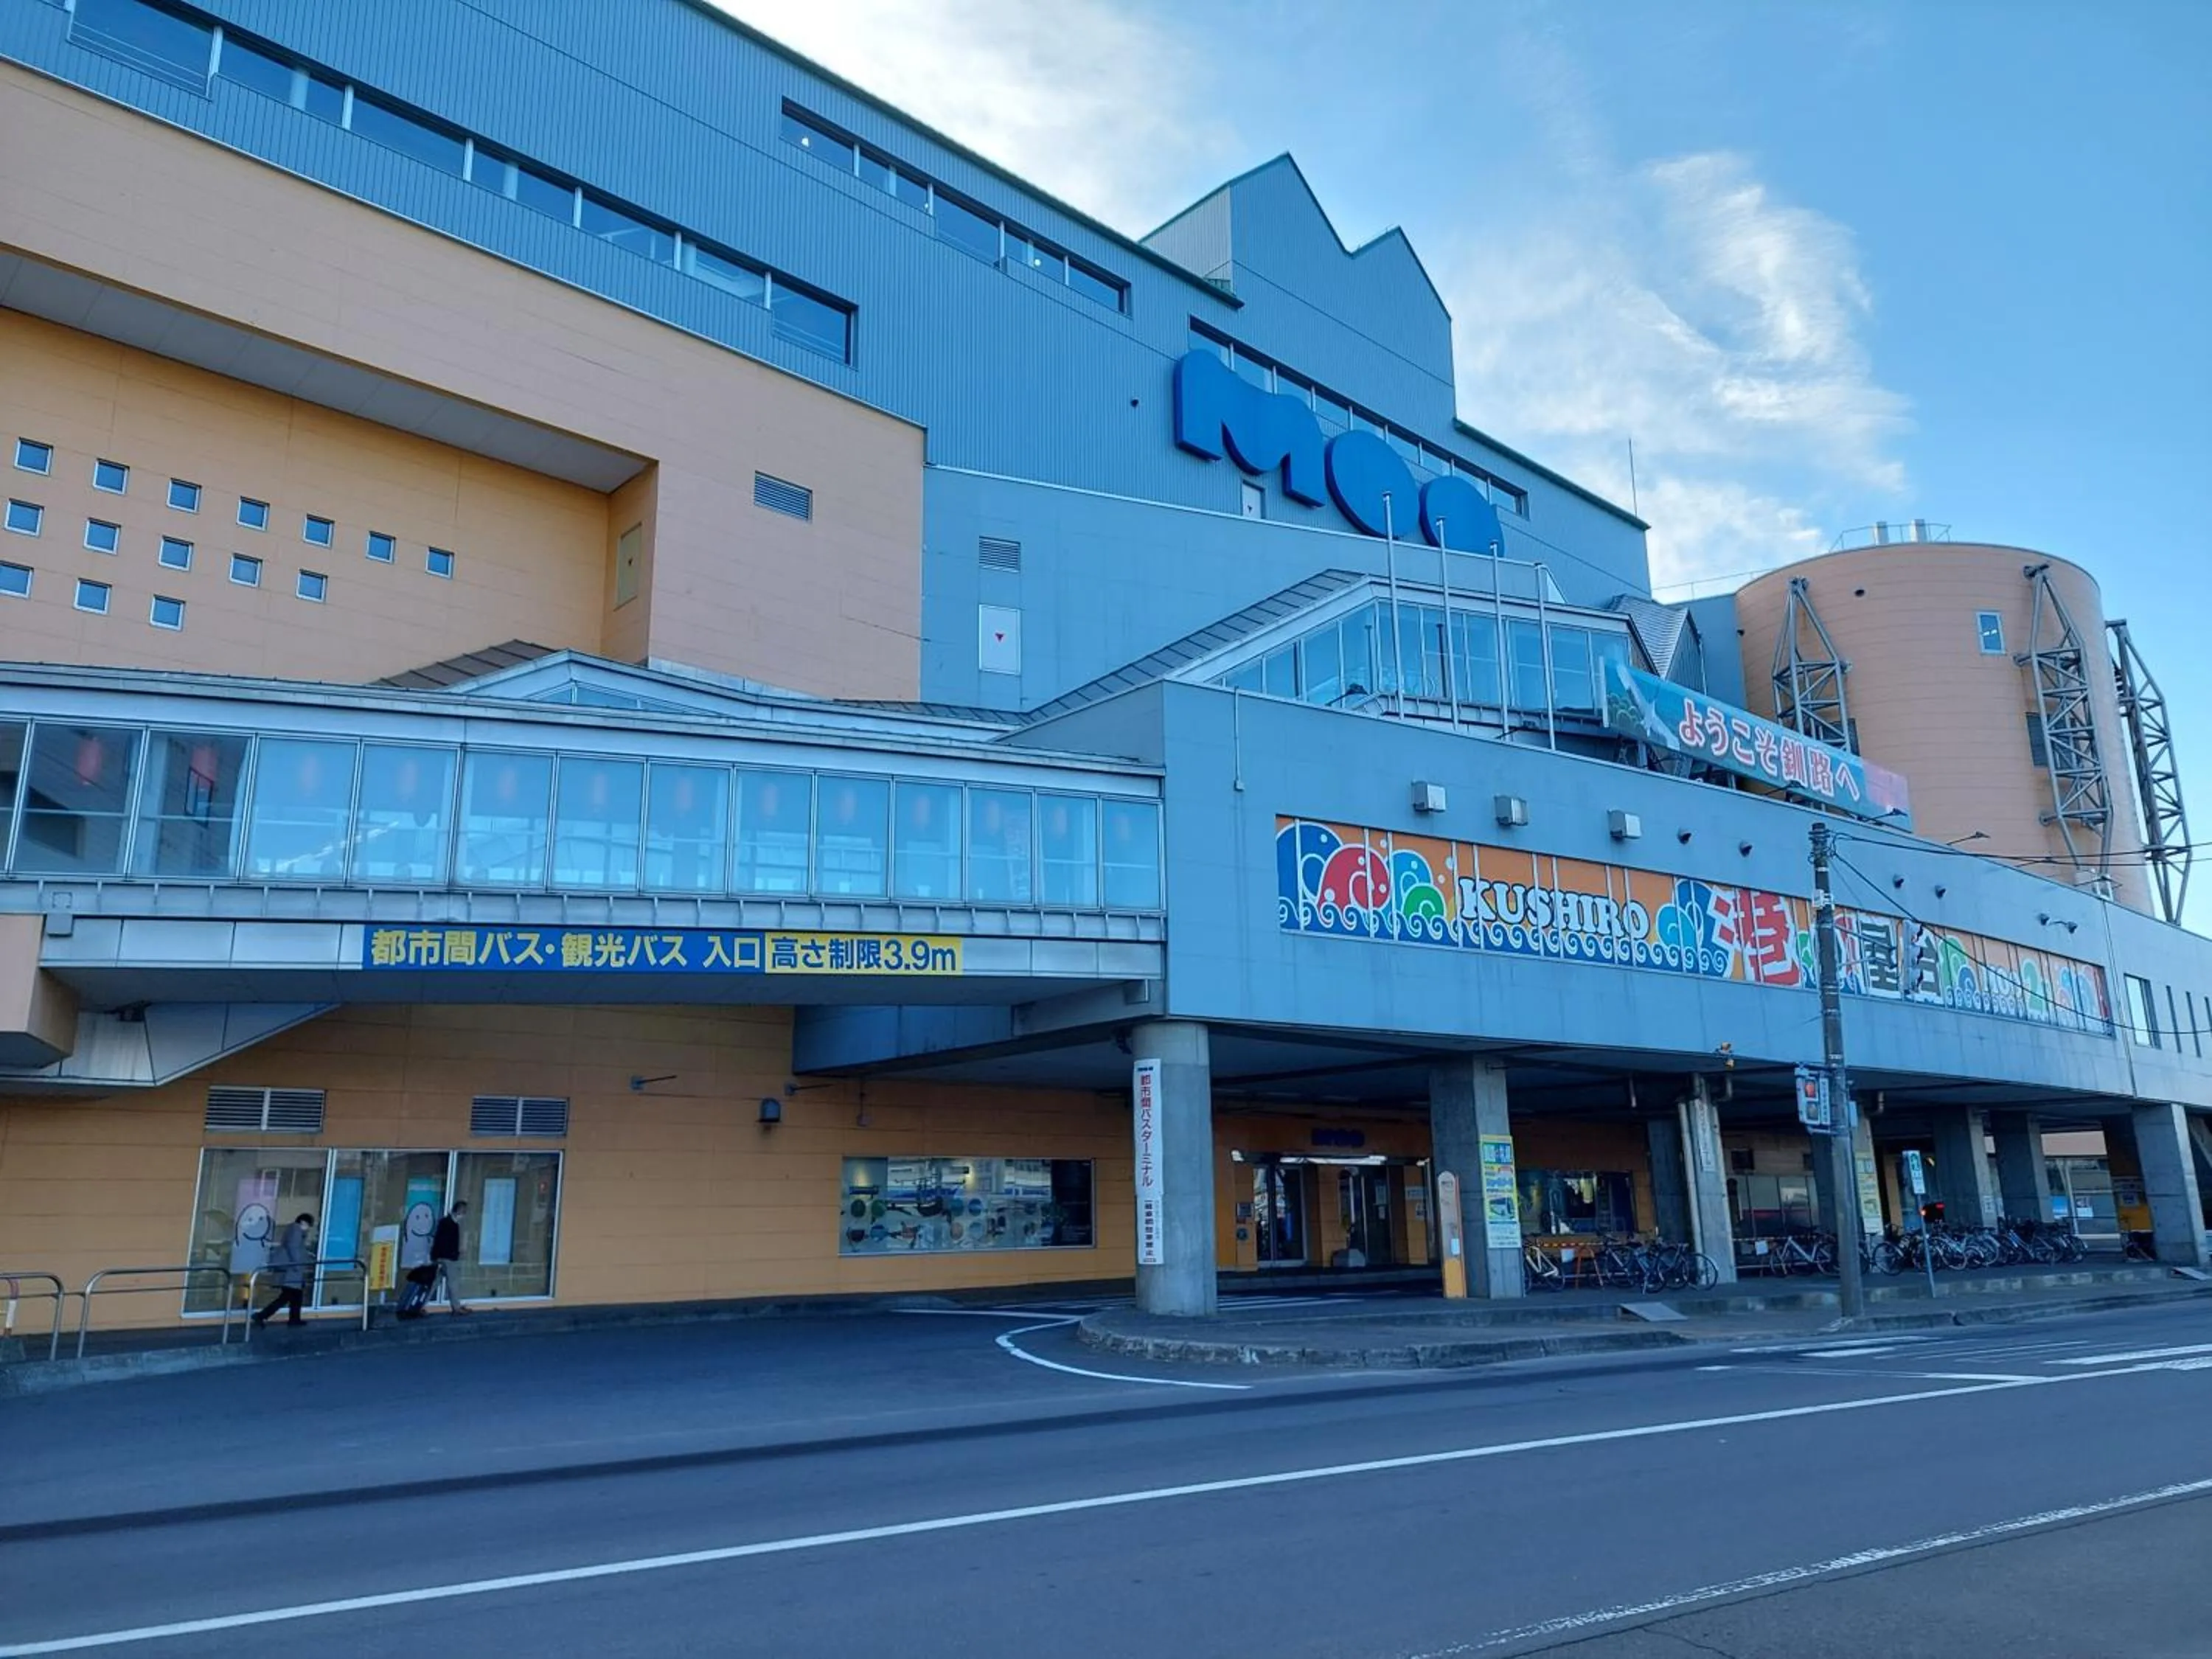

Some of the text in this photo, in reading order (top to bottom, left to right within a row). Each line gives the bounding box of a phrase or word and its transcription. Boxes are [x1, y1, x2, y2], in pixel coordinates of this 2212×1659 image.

[1679, 698, 1860, 802] ようこそ釧路へ
[1458, 876, 1650, 940] KUSHIRO
[371, 928, 760, 968] 都市間バス・観光バス 入口
[771, 936, 956, 971] 高さ制限3.9m
